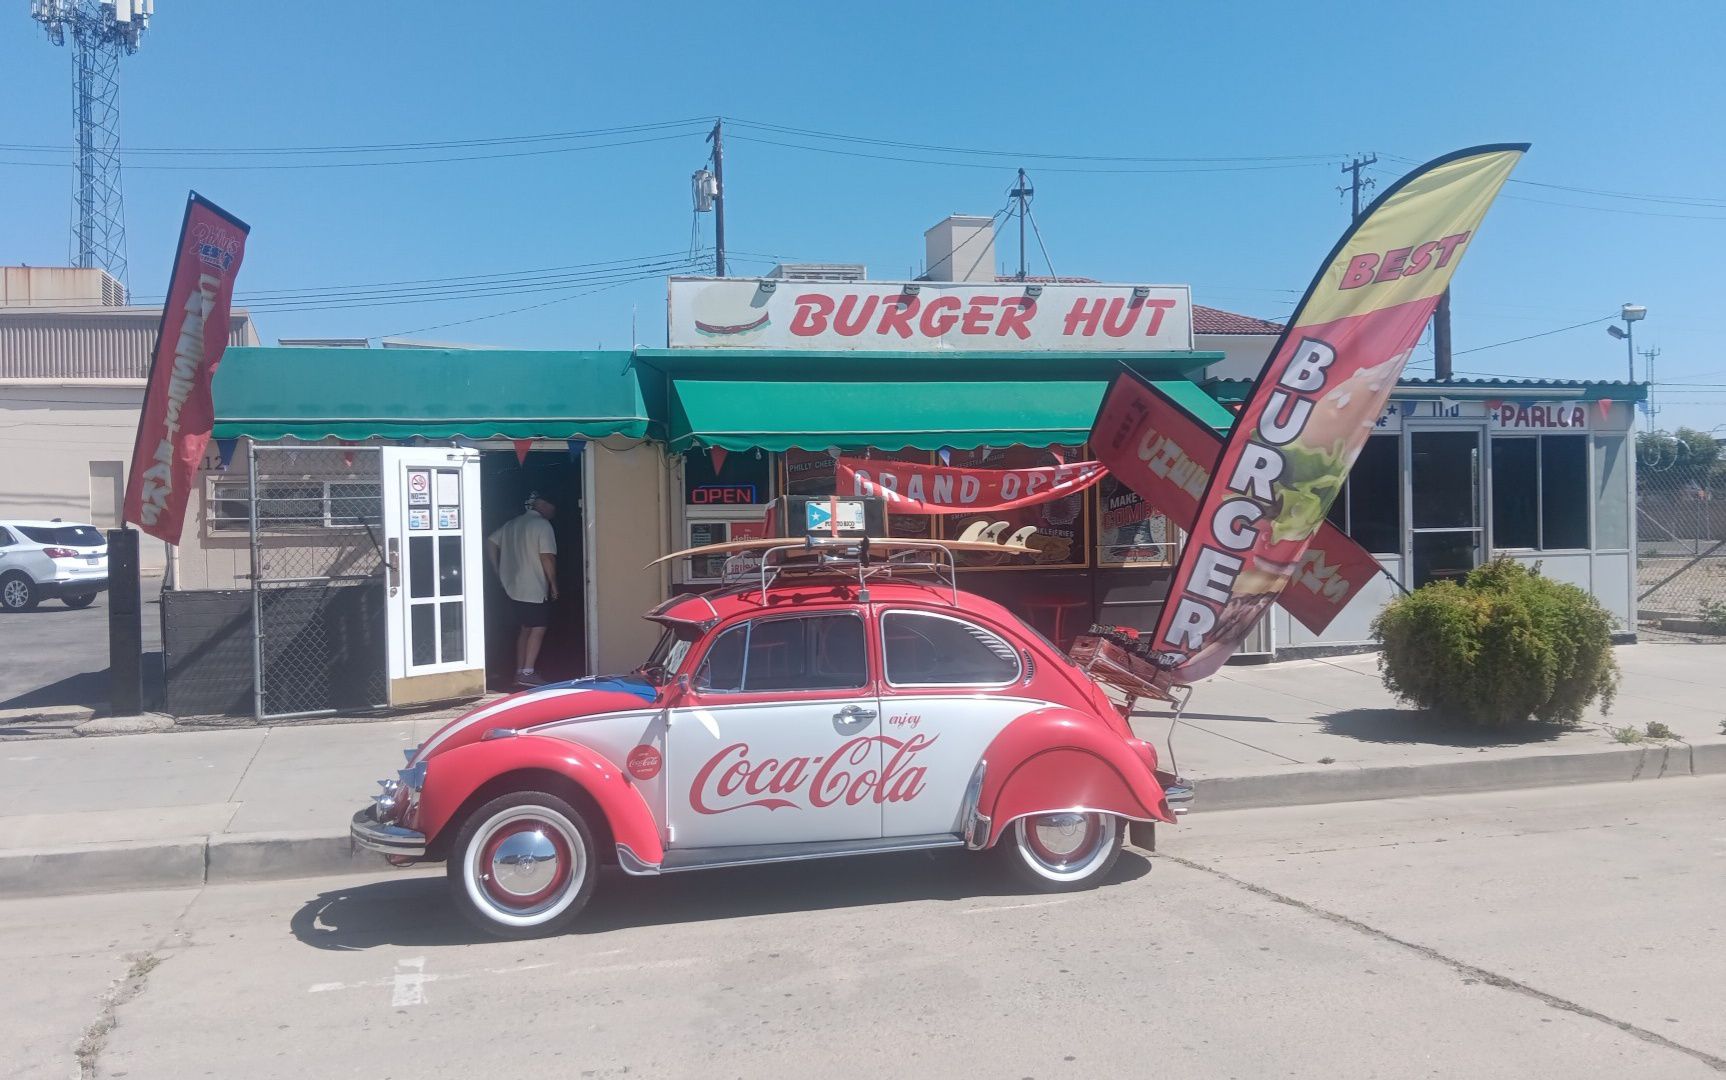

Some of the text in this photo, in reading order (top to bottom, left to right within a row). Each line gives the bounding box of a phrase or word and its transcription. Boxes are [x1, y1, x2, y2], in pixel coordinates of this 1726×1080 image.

[1338, 231, 1471, 290] BEST
[789, 294, 1176, 340] BURGER HUT
[692, 488, 750, 503] OPEN
[853, 470, 980, 503] GRAND
[1110, 493, 1138, 509] MAKE
[1160, 337, 1336, 664] BURGER
[889, 713, 921, 728] enjoy
[689, 732, 940, 815] Coca-Cola
